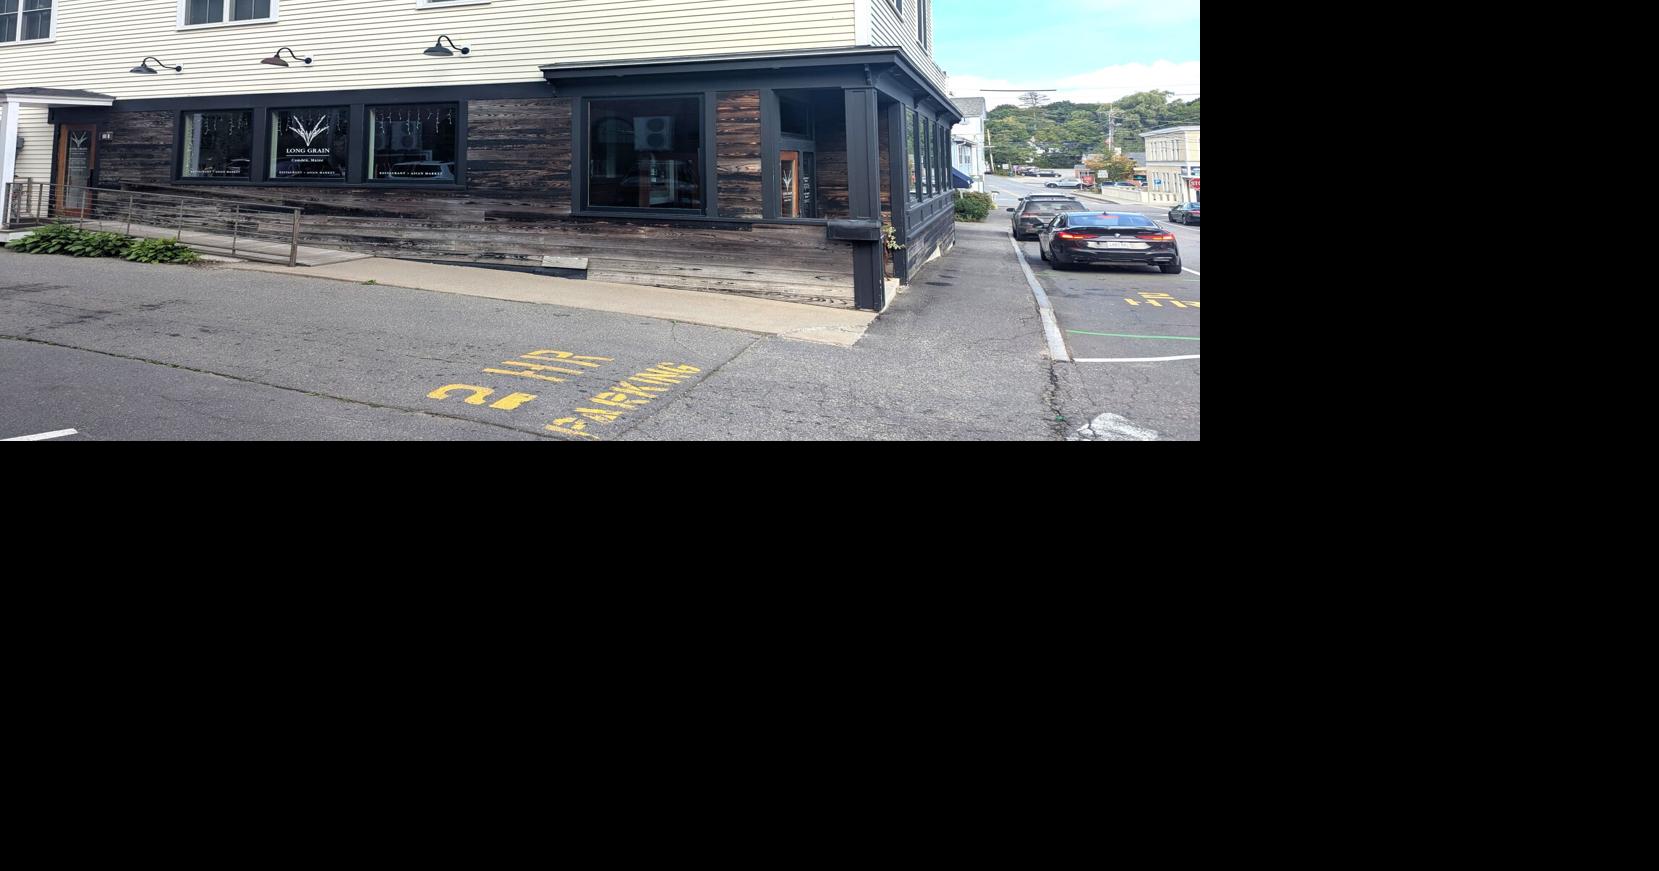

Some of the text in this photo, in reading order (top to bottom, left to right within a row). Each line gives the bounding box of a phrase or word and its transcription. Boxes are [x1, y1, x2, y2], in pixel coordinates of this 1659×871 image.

[426, 349, 615, 410] 2 HR
[544, 361, 701, 440] PARKING
